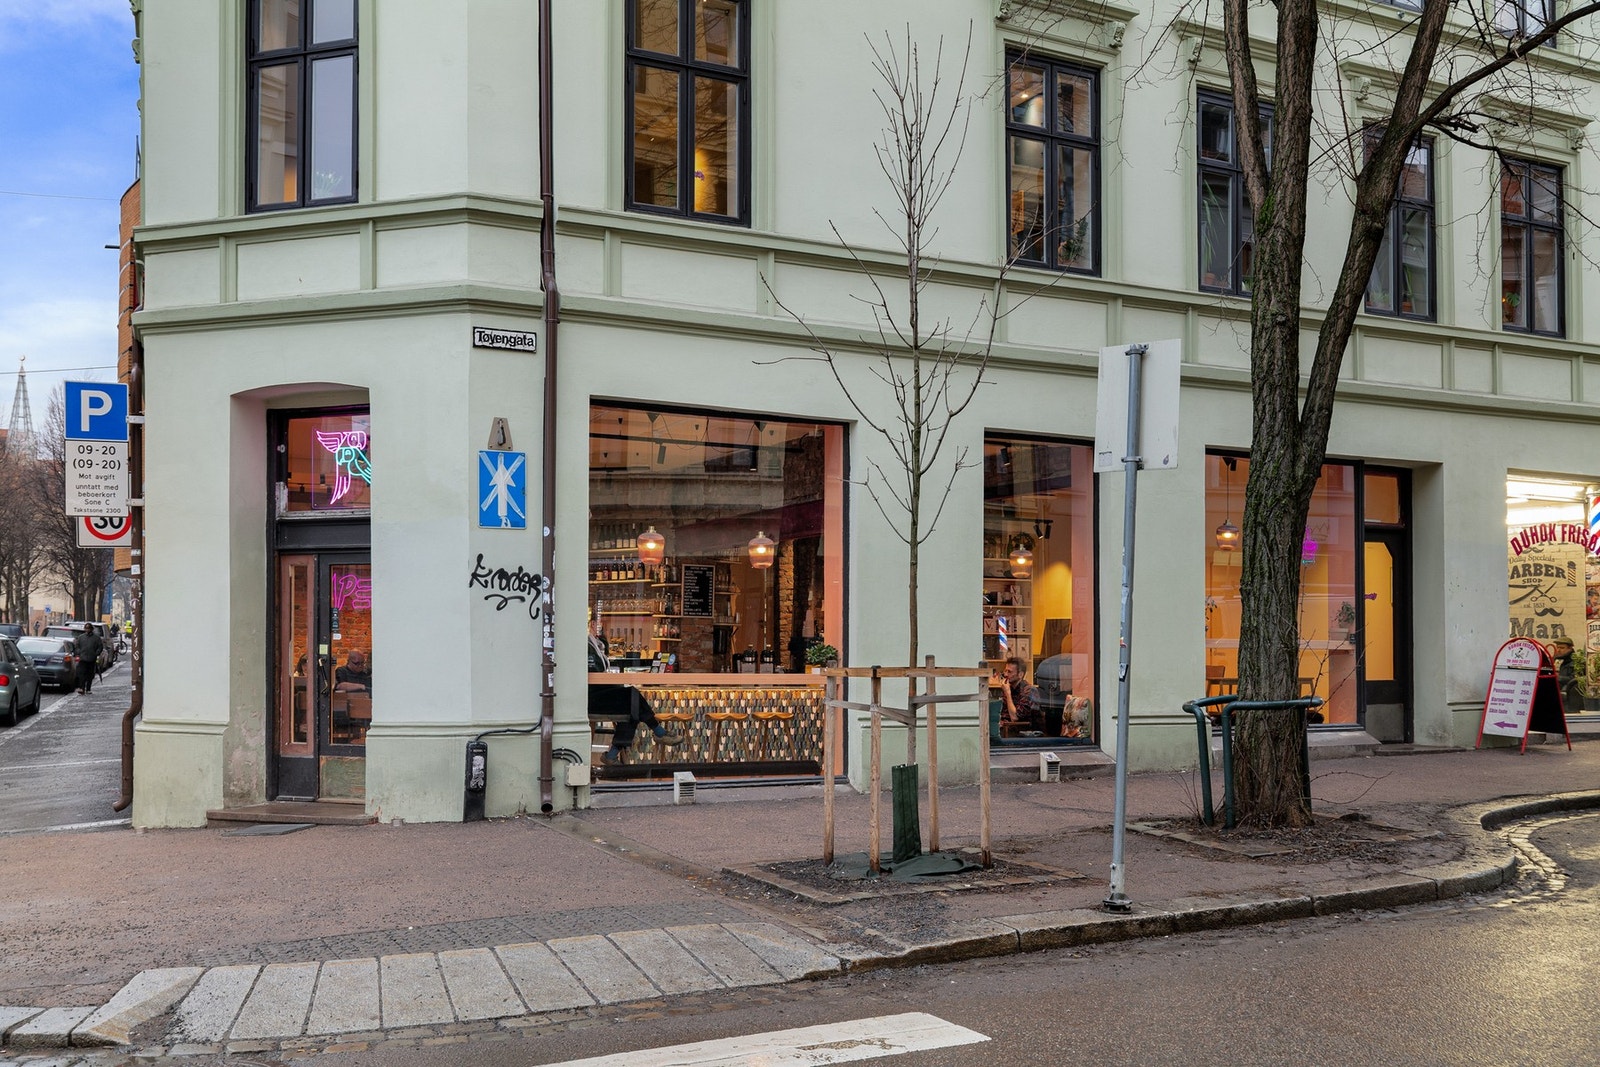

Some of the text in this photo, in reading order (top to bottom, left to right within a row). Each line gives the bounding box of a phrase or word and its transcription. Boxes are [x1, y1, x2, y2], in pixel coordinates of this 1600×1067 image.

[476, 330, 535, 347] Tøyengata
[81, 389, 112, 431] P
[73, 458, 121, 470] (09-20)
[95, 473, 115, 481] avgift
[1510, 523, 1557, 556] DUHOK
[1509, 617, 1566, 639] Man
